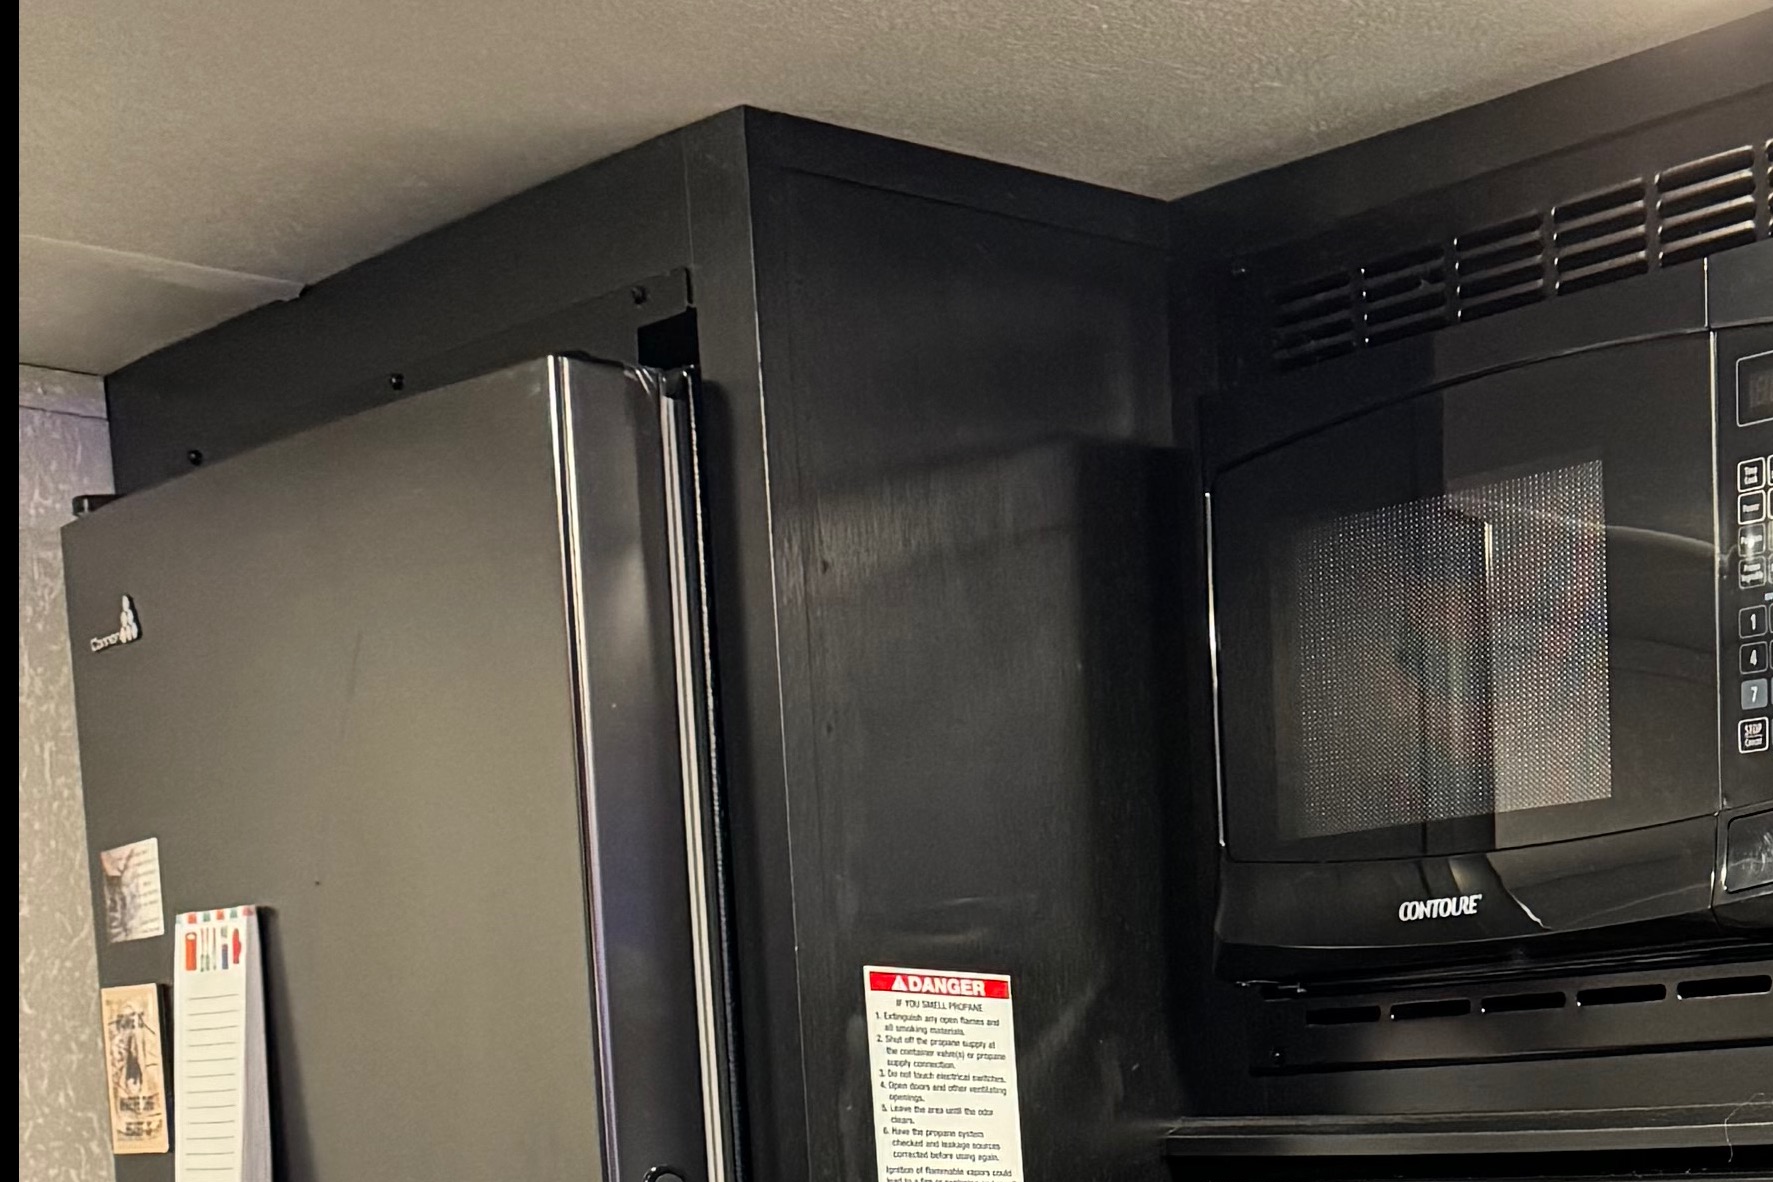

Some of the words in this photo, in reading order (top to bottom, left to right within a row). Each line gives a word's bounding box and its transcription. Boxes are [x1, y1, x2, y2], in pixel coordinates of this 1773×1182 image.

[1751, 614, 1756, 630] 1
[1750, 650, 1757, 666] 4
[1751, 686, 1758, 702] 7
[1745, 723, 1762, 734] STOP
[1399, 894, 1482, 921] CONTOURE
[908, 977, 986, 996] DANGER
[904, 999, 920, 1008] YOU
[921, 1000, 946, 1009] SMELL
[947, 1001, 982, 1012] PROPANE
